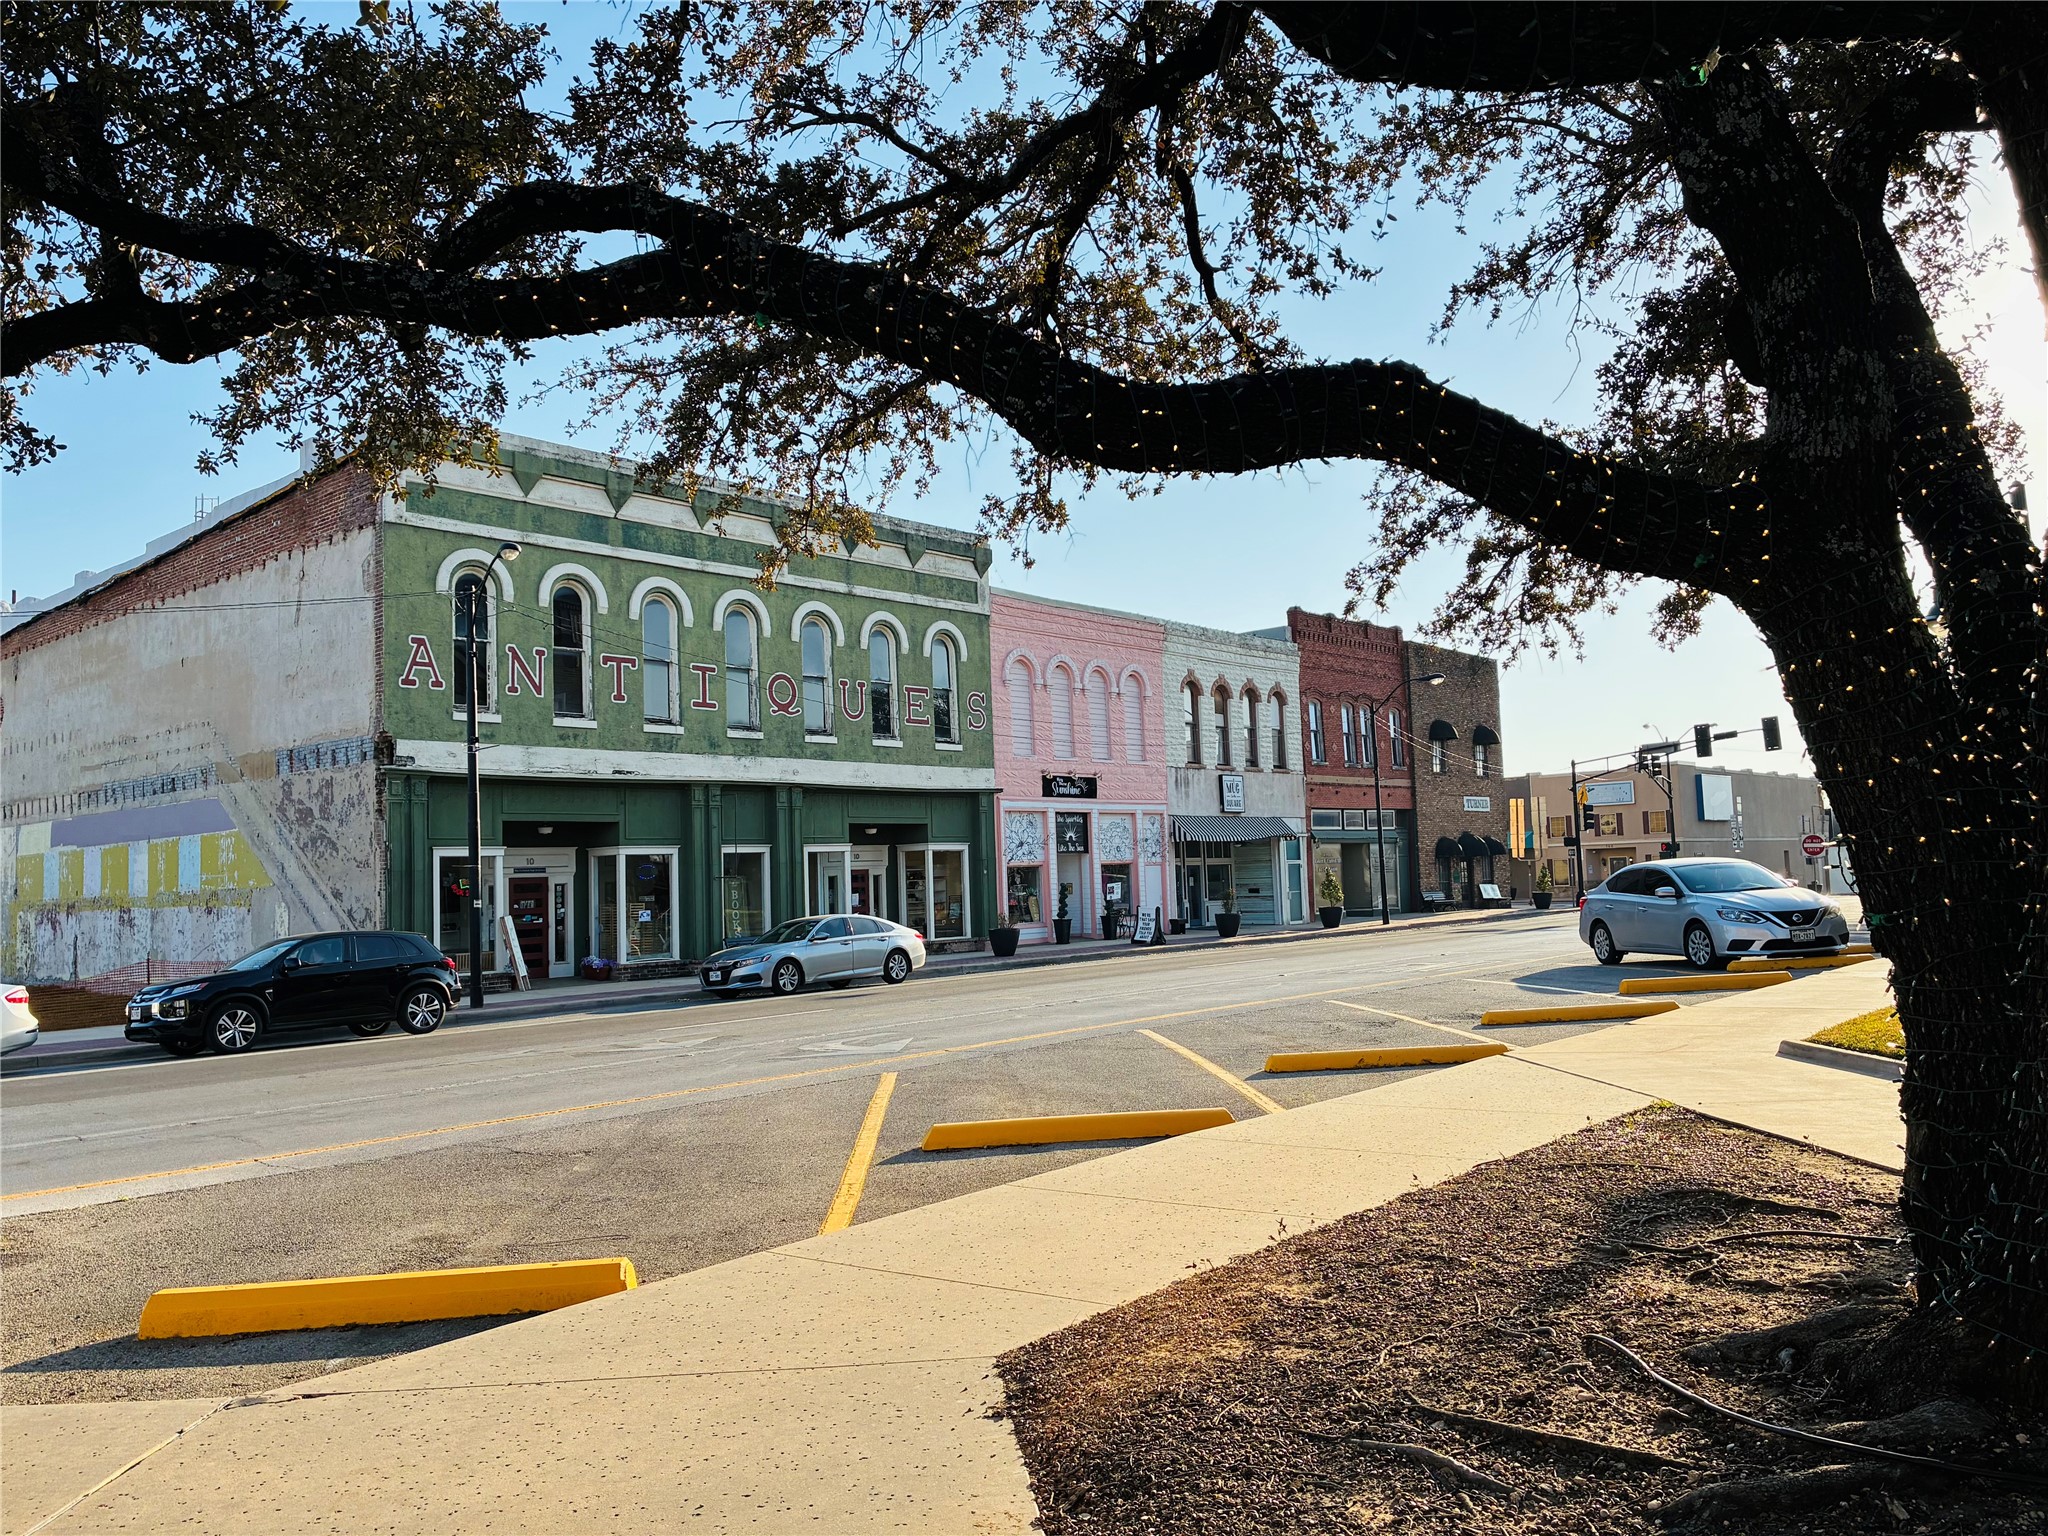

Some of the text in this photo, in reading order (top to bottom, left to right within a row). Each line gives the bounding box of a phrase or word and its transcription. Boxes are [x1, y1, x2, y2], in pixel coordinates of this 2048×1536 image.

[398, 634, 987, 731] ANTIQUES
[1052, 781, 1081, 797] Sunshine
[1226, 782, 1240, 794] MUG
[1466, 799, 1489, 808] TURNER
[731, 890, 742, 938] BOOKS
